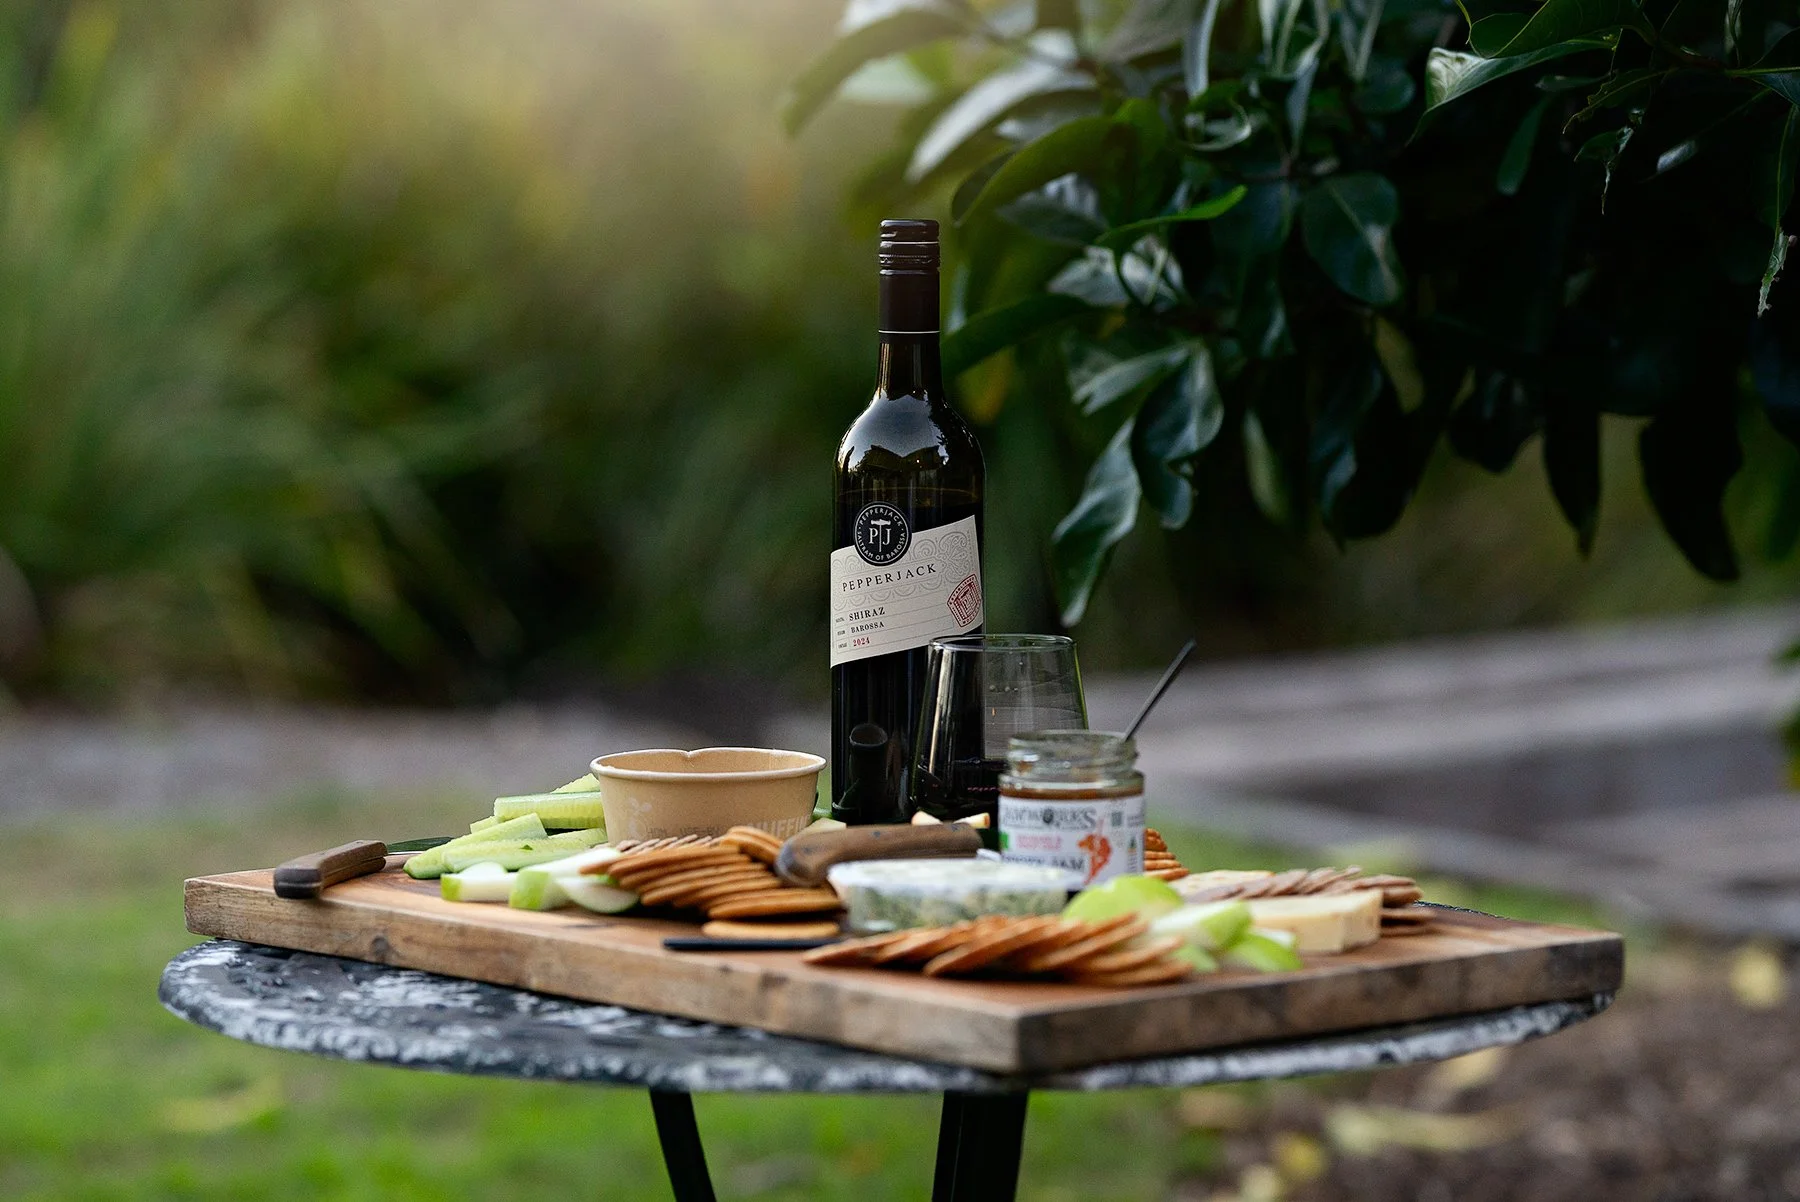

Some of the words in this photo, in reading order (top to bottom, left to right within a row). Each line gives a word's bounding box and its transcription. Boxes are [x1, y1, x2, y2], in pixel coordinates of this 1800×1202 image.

[859, 507, 903, 527] PEPPERJACK
[885, 532, 906, 560] BAROSSA
[842, 563, 937, 592] PEPPERJACK
[849, 606, 886, 621] SHIRAZ
[851, 621, 885, 634] BAROSSA
[853, 637, 870, 648] 2024
